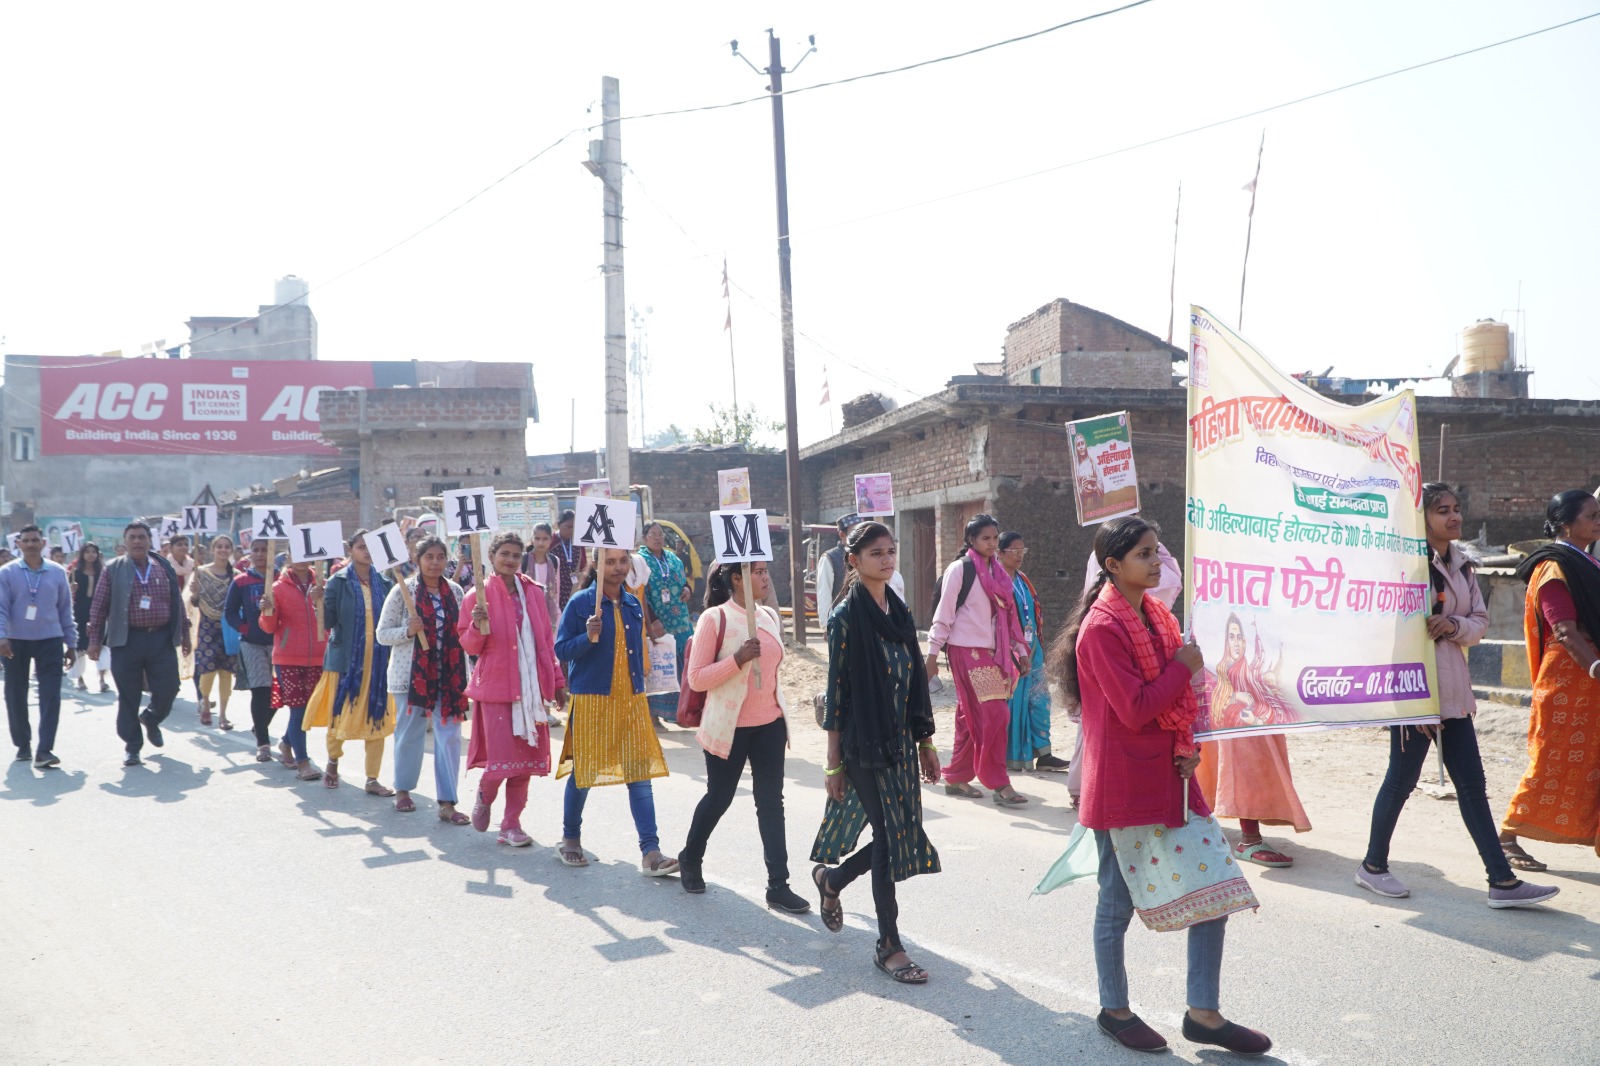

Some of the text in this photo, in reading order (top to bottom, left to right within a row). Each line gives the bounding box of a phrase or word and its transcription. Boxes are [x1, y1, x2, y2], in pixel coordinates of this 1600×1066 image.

[53, 382, 169, 421] ACC
[191, 389, 241, 400] INDIA'S
[197, 408, 241, 416] COMPANY
[1189, 395, 1240, 452] महिला
[65, 429, 237, 443] Building India Since 1936
[183, 507, 208, 531] M
[258, 510, 288, 538] A
[455, 494, 491, 532] H
[580, 503, 618, 546] A
[1207, 503, 1283, 543] अहिल्याबाई
[1283, 514, 1331, 545] होल्कर
[1331, 520, 1344, 546] के
[1344, 524, 1361, 548] 300
[300, 528, 328, 559] L
[377, 531, 399, 565] I
[719, 513, 767, 558] M
[1192, 555, 1428, 617] प्रभात फेरी का कार्यक्रम
[653, 663, 674, 671] Thank
[1302, 668, 1355, 699] दिनांक
